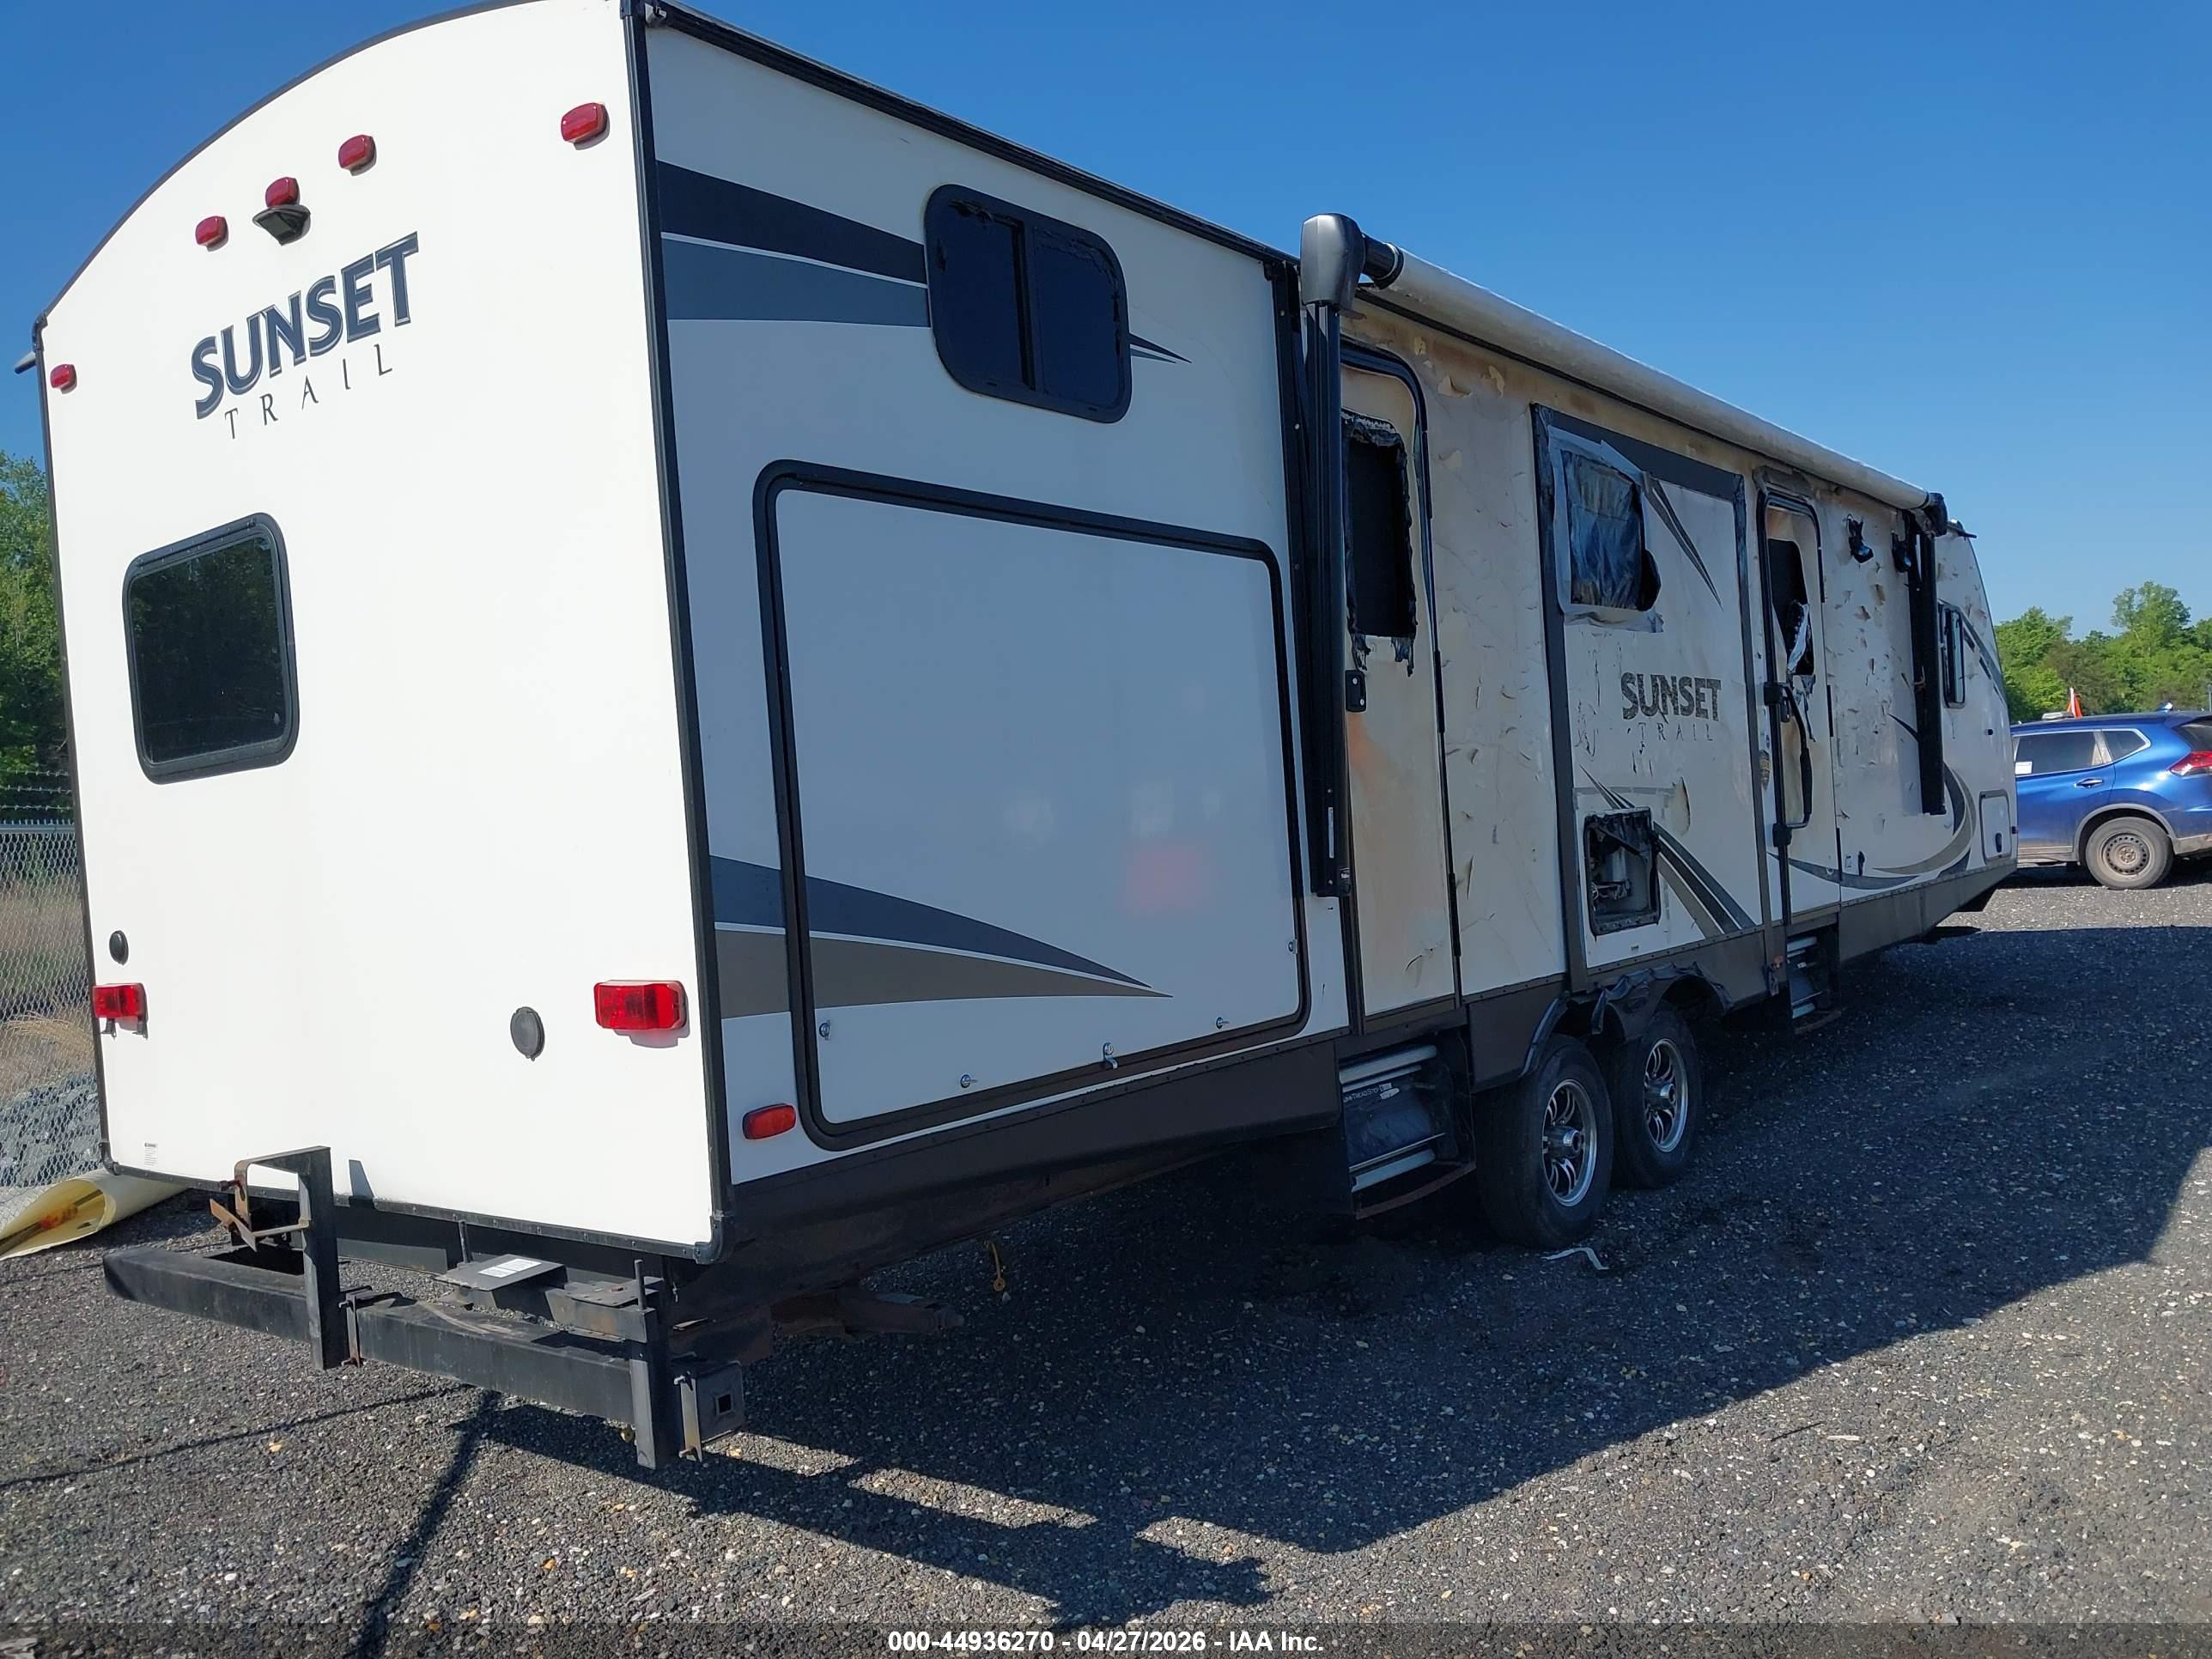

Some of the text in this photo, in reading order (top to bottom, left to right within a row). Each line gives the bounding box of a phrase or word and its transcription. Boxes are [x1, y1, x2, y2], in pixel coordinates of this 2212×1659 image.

[191, 231, 419, 420] SUNSET
[224, 343, 392, 439] TRAIL
[1620, 672, 1722, 721] SUNSET
[1638, 722, 1713, 741] TRAIL
